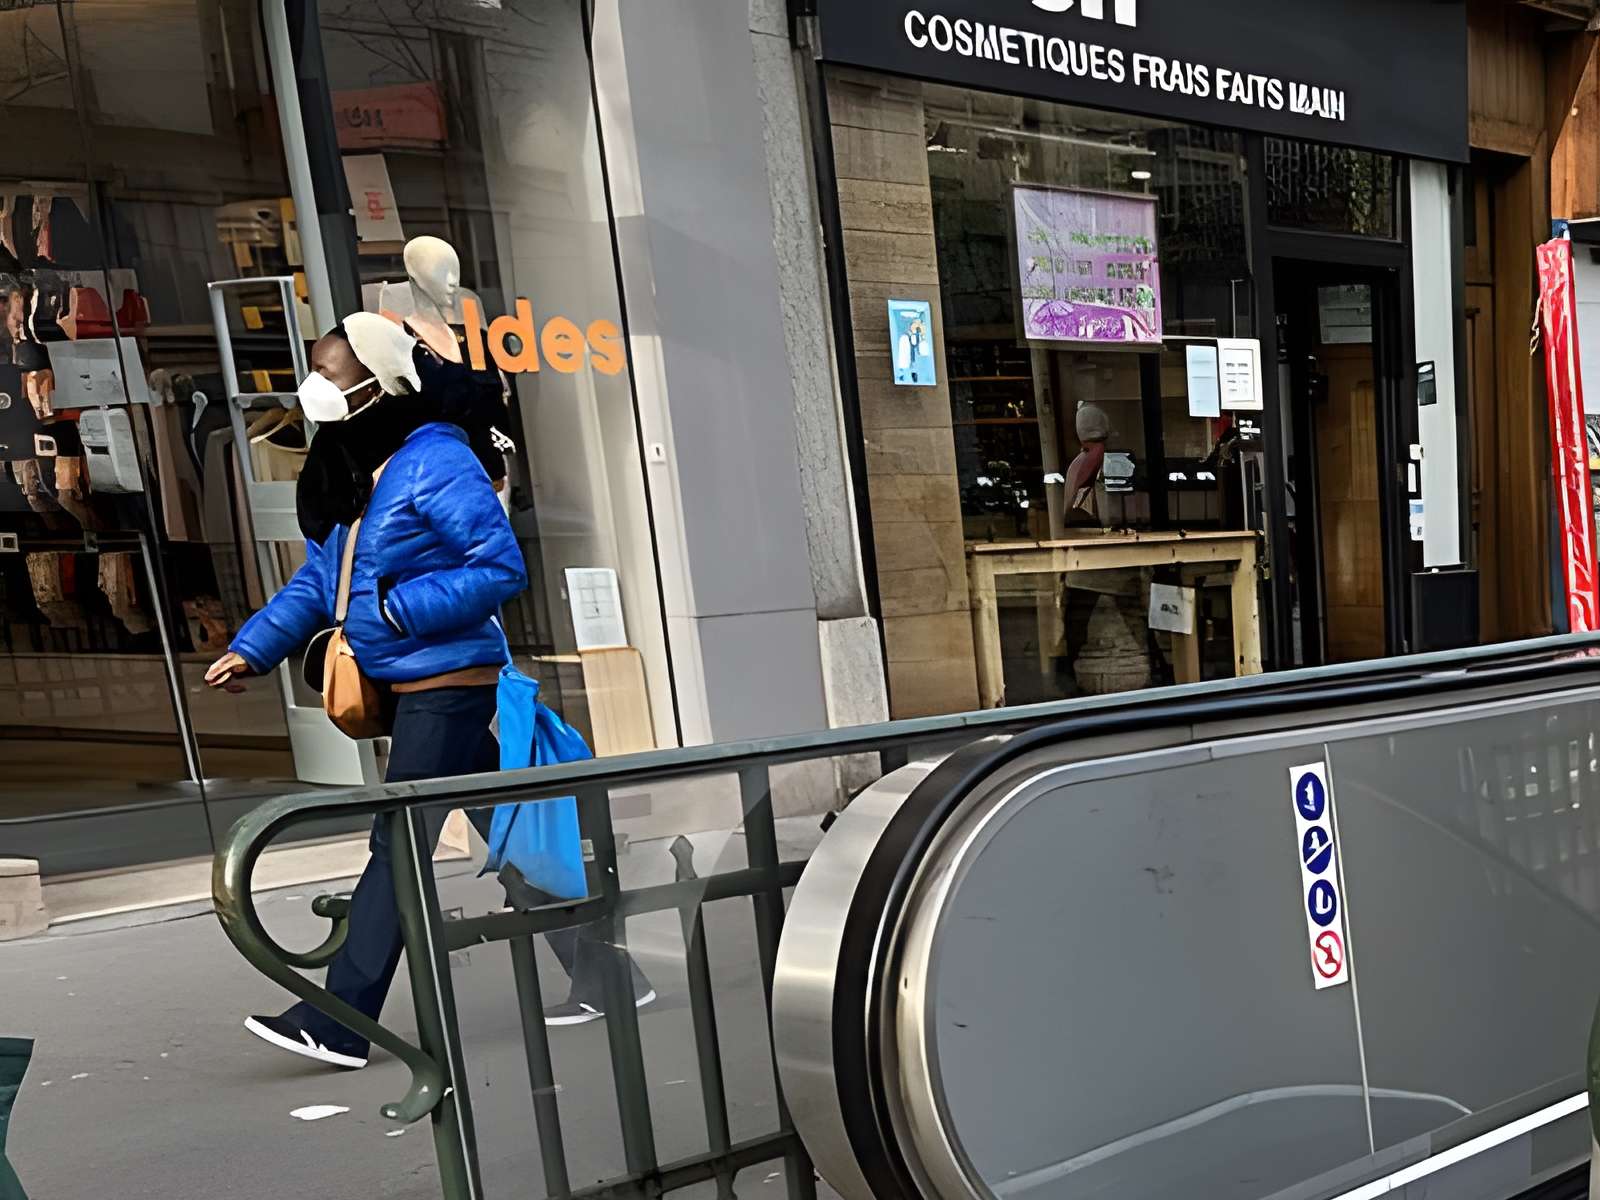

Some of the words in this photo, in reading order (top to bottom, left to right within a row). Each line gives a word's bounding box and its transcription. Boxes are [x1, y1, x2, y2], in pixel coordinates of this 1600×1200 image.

[903, 10, 1125, 83] COSMETIQUES
[1132, 53, 1209, 98] FRAIS
[1216, 68, 1283, 110] FAITS
[461, 296, 626, 376] ldes
